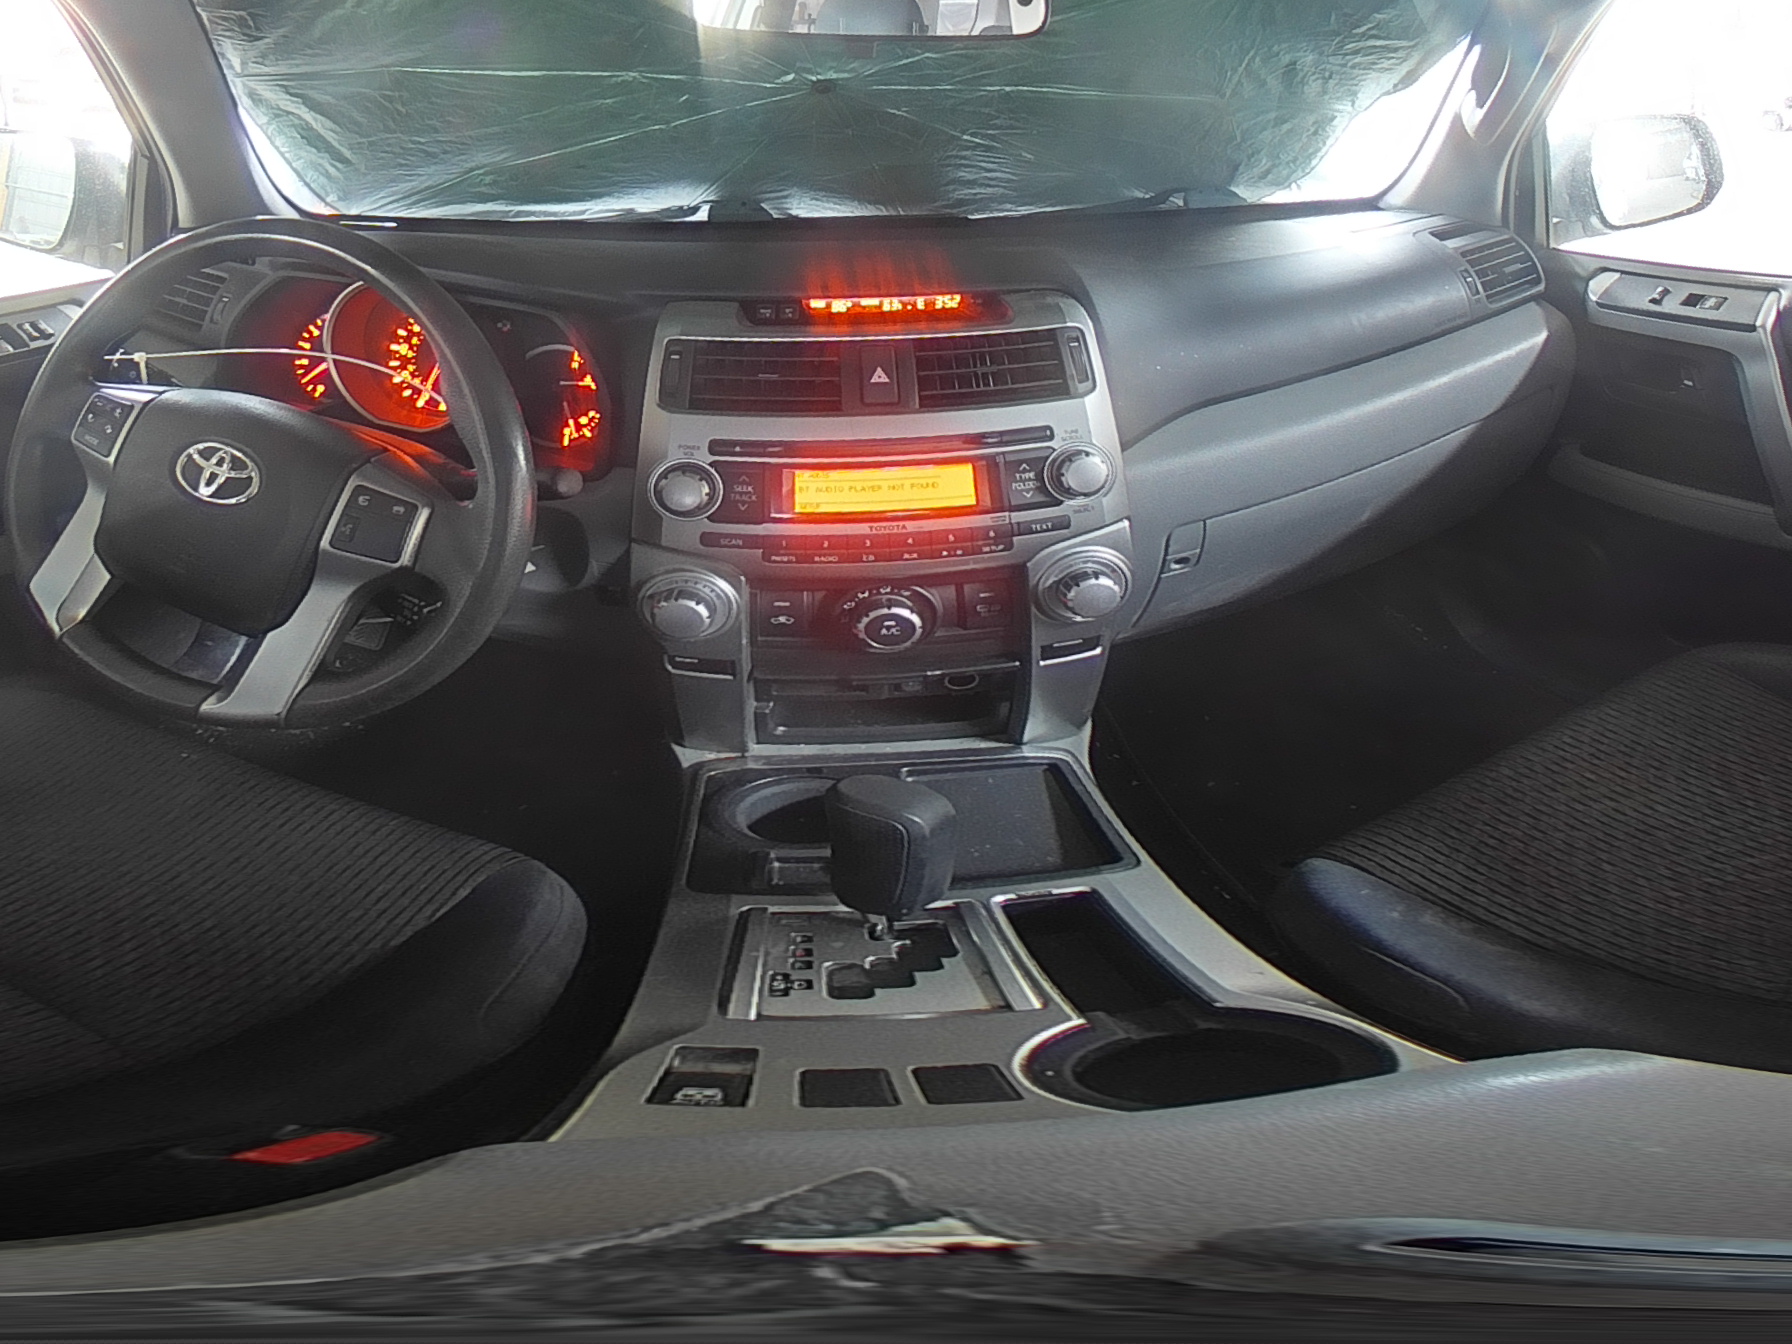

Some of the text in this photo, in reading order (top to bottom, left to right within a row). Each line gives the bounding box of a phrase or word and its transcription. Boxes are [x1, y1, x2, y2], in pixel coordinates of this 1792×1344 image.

[1015, 471, 1036, 480] TYPE
[733, 484, 754, 493] SEEK
[848, 484, 882, 493] PLAYER
[910, 481, 939, 490] FOUND
[730, 493, 758, 502] TRACK
[868, 523, 909, 533] TOYOTA
[1030, 522, 1053, 531] TEXT
[720, 538, 743, 546] SCAN
[880, 626, 902, 636] A/C
